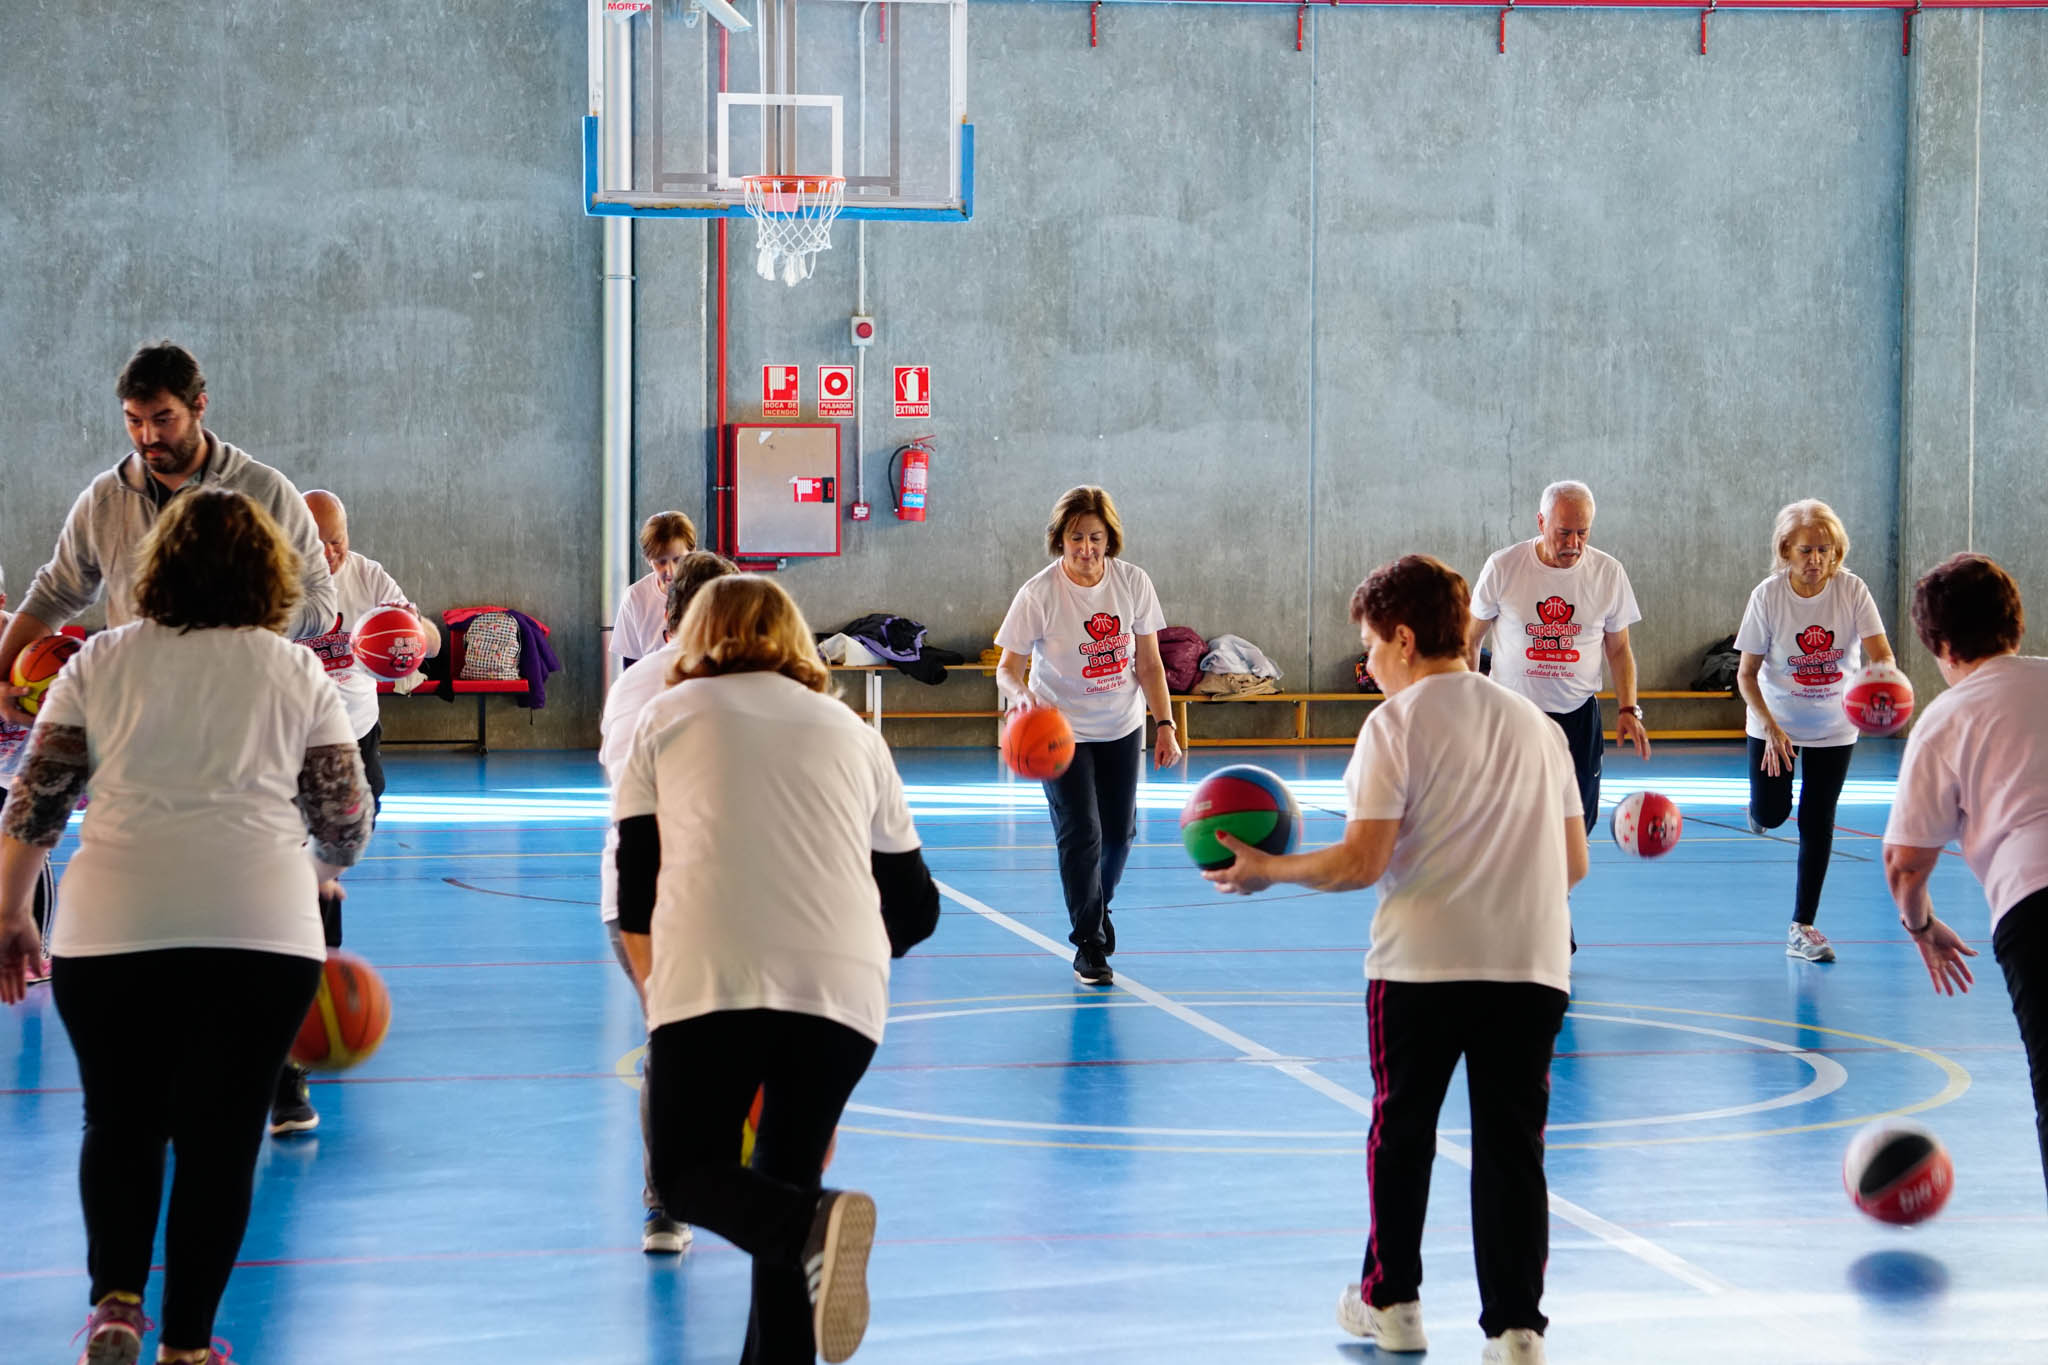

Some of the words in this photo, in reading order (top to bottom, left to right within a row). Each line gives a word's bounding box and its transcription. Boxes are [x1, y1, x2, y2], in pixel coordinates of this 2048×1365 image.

[896, 405, 929, 416] EXTINTOR
[1526, 620, 1582, 638] SuperSenior
[1081, 632, 1130, 655] SuperSenior
[1789, 648, 1844, 666] SuperSenior
